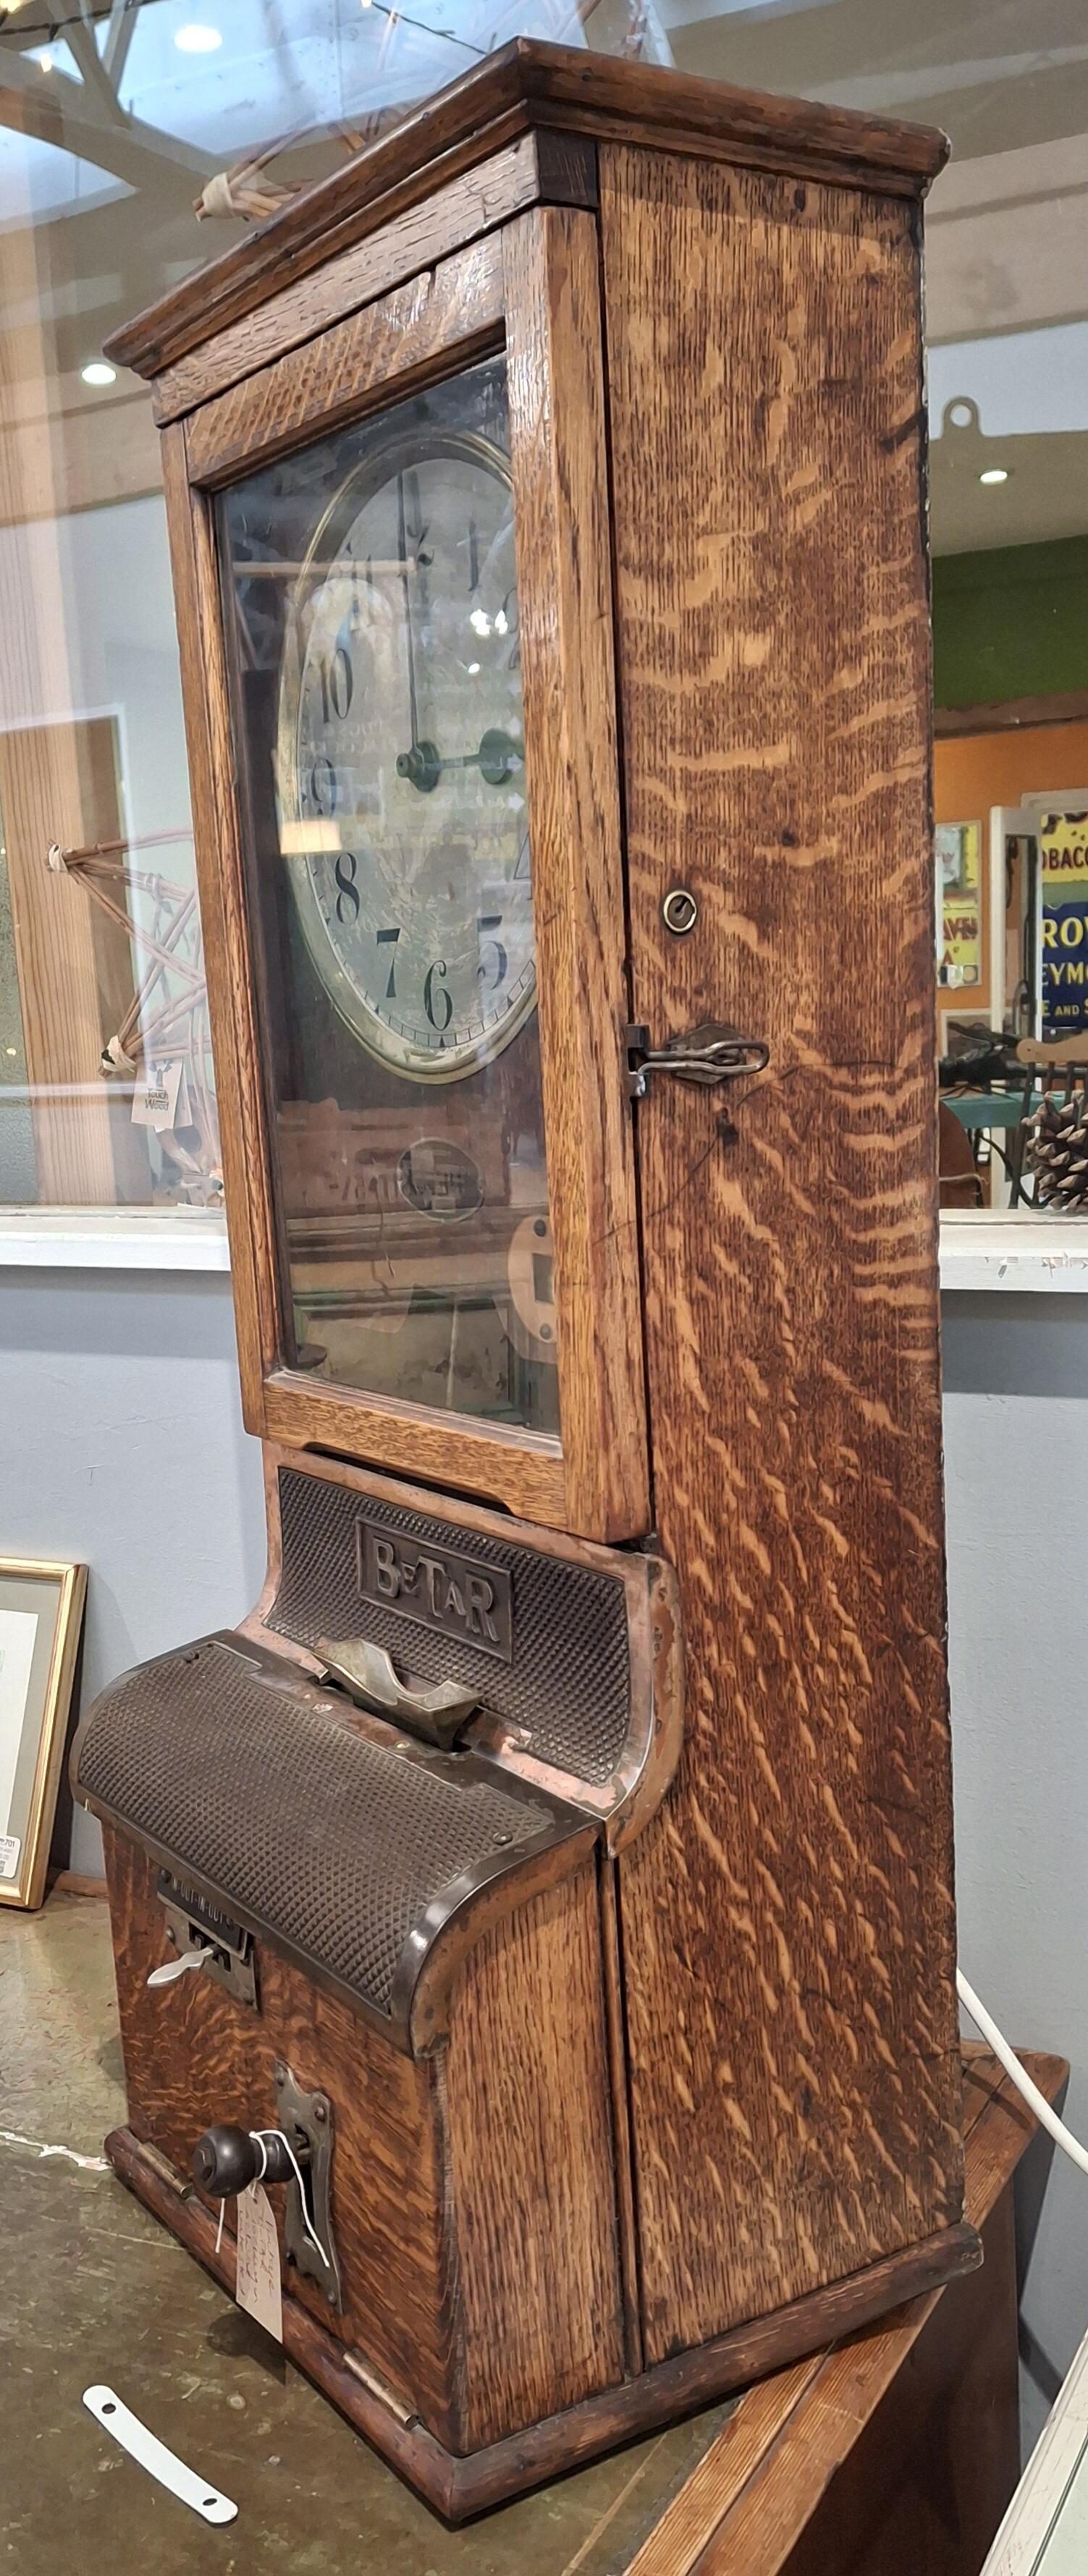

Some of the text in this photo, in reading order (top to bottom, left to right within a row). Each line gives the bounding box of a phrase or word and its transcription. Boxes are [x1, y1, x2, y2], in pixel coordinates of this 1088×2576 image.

[320, 648, 353, 724] 10
[311, 758, 337, 818] 9
[335, 852, 360, 924] 8
[477, 915, 507, 990] 5
[1042, 916, 1088, 949] RO
[376, 928, 400, 998] 7
[1042, 962, 1088, 986] EYM
[424, 960, 453, 1031] 6
[1055, 1004, 1080, 1016] AND
[145, 1098, 169, 1111] Wood
[147, 1088, 169, 1100] Touch
